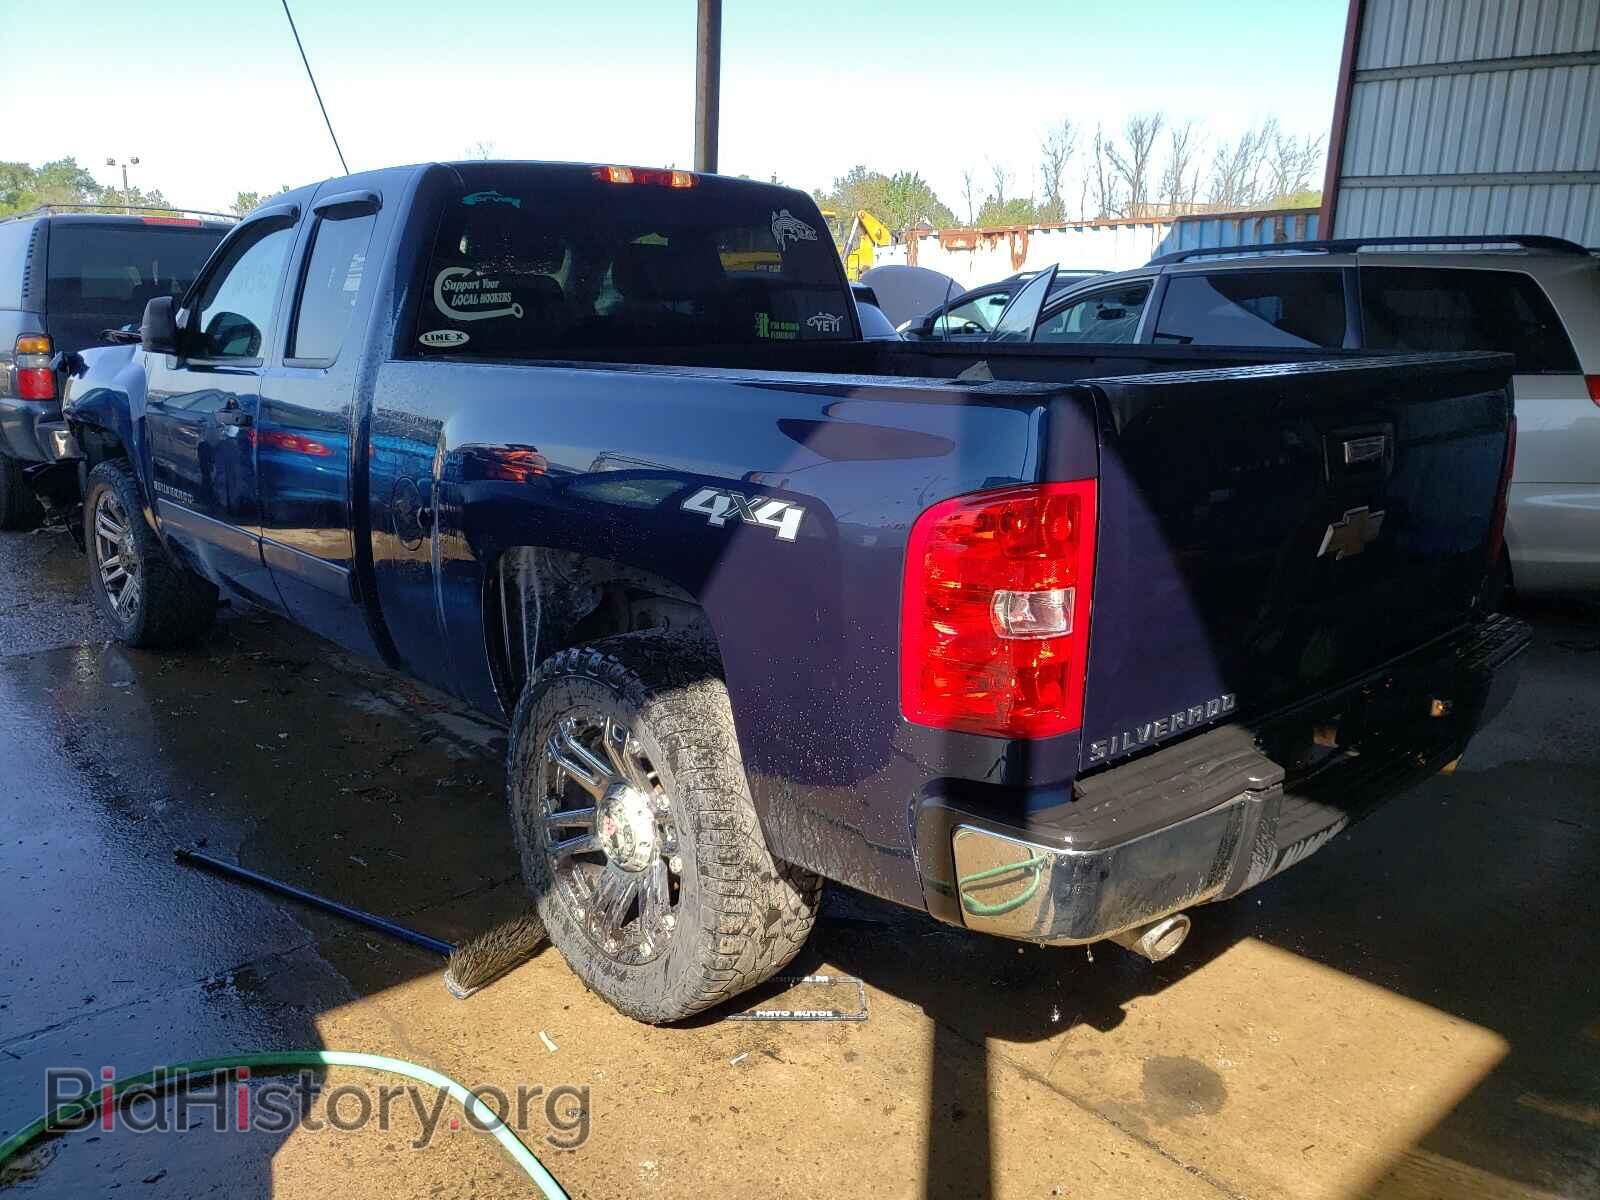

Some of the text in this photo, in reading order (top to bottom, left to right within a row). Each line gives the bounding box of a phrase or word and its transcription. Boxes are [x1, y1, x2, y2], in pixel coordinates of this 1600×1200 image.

[443, 279, 500, 292] Support Your
[451, 292, 512, 306] LOCAL HOOKERS
[815, 320, 840, 332] YETI
[1089, 693, 1236, 762] SILVERADO
